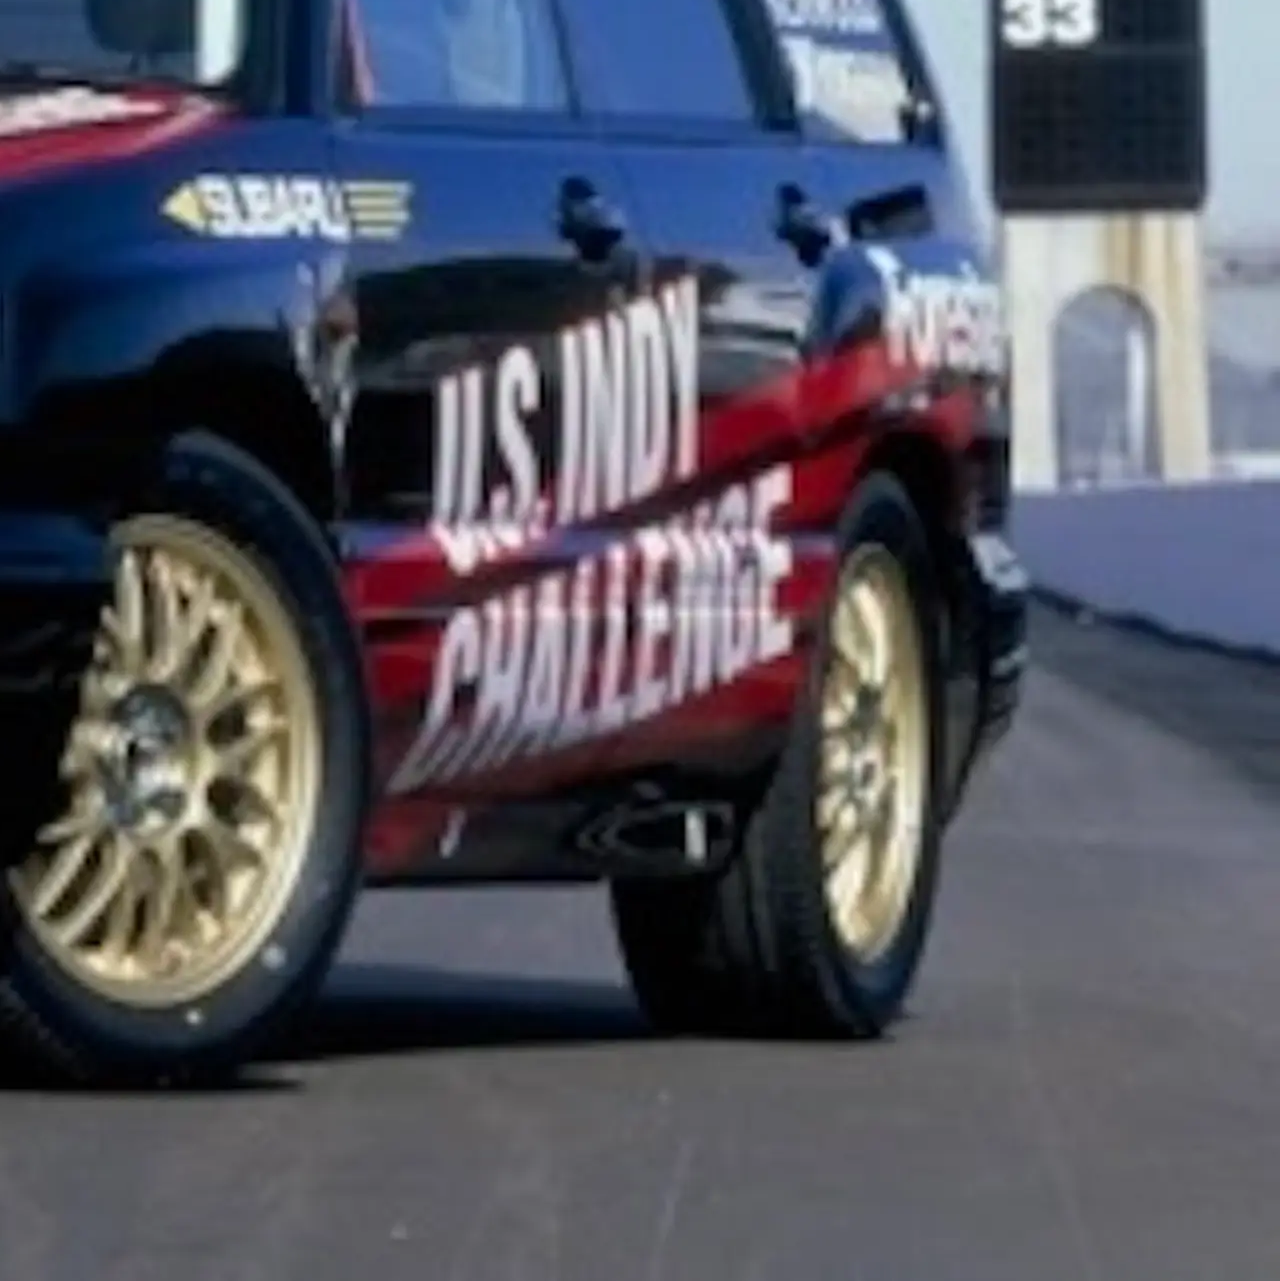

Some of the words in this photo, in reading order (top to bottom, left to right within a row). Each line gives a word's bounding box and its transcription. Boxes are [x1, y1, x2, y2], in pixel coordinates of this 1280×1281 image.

[430, 344, 553, 575] U.S.
[555, 274, 700, 527] INDY
[387, 460, 795, 798] CHALLENGE
